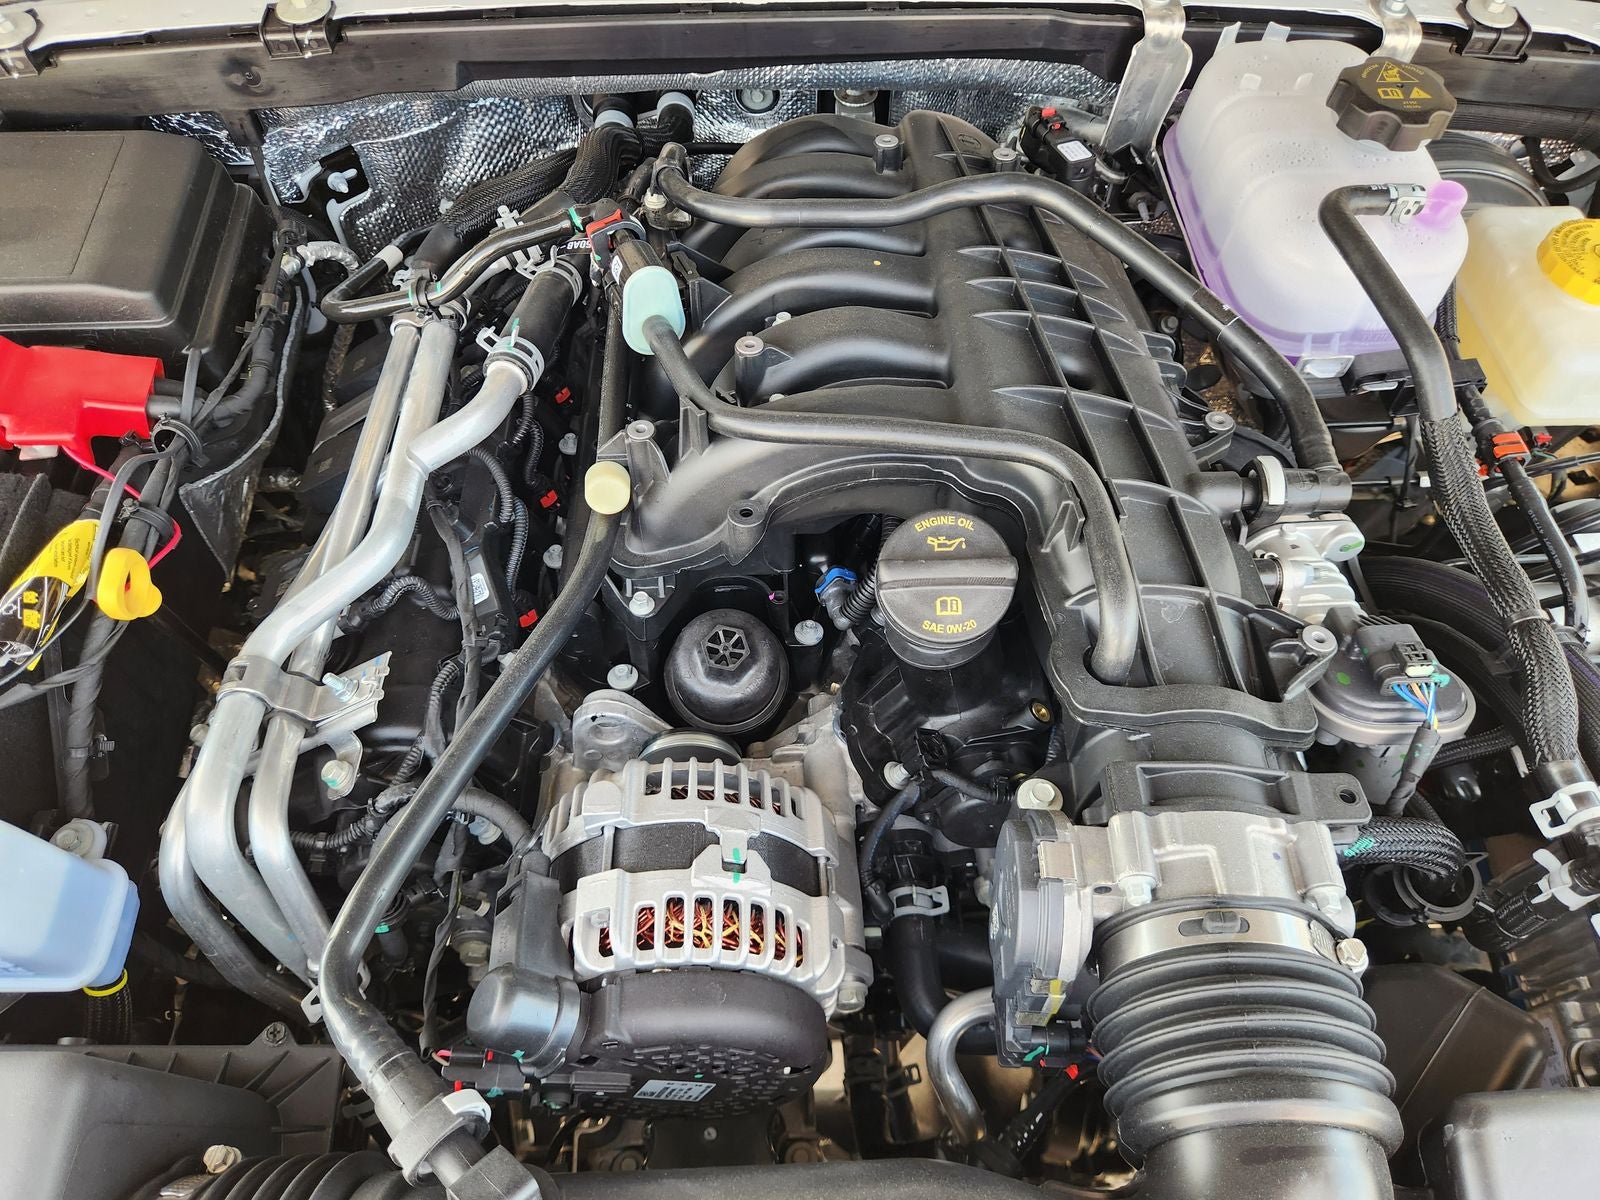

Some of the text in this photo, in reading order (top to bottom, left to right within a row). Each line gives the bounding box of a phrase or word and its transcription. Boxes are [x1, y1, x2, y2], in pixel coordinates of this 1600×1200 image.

[914, 516, 975, 532] ENGINE OIL
[922, 619, 977, 634] SAE 0W-20
